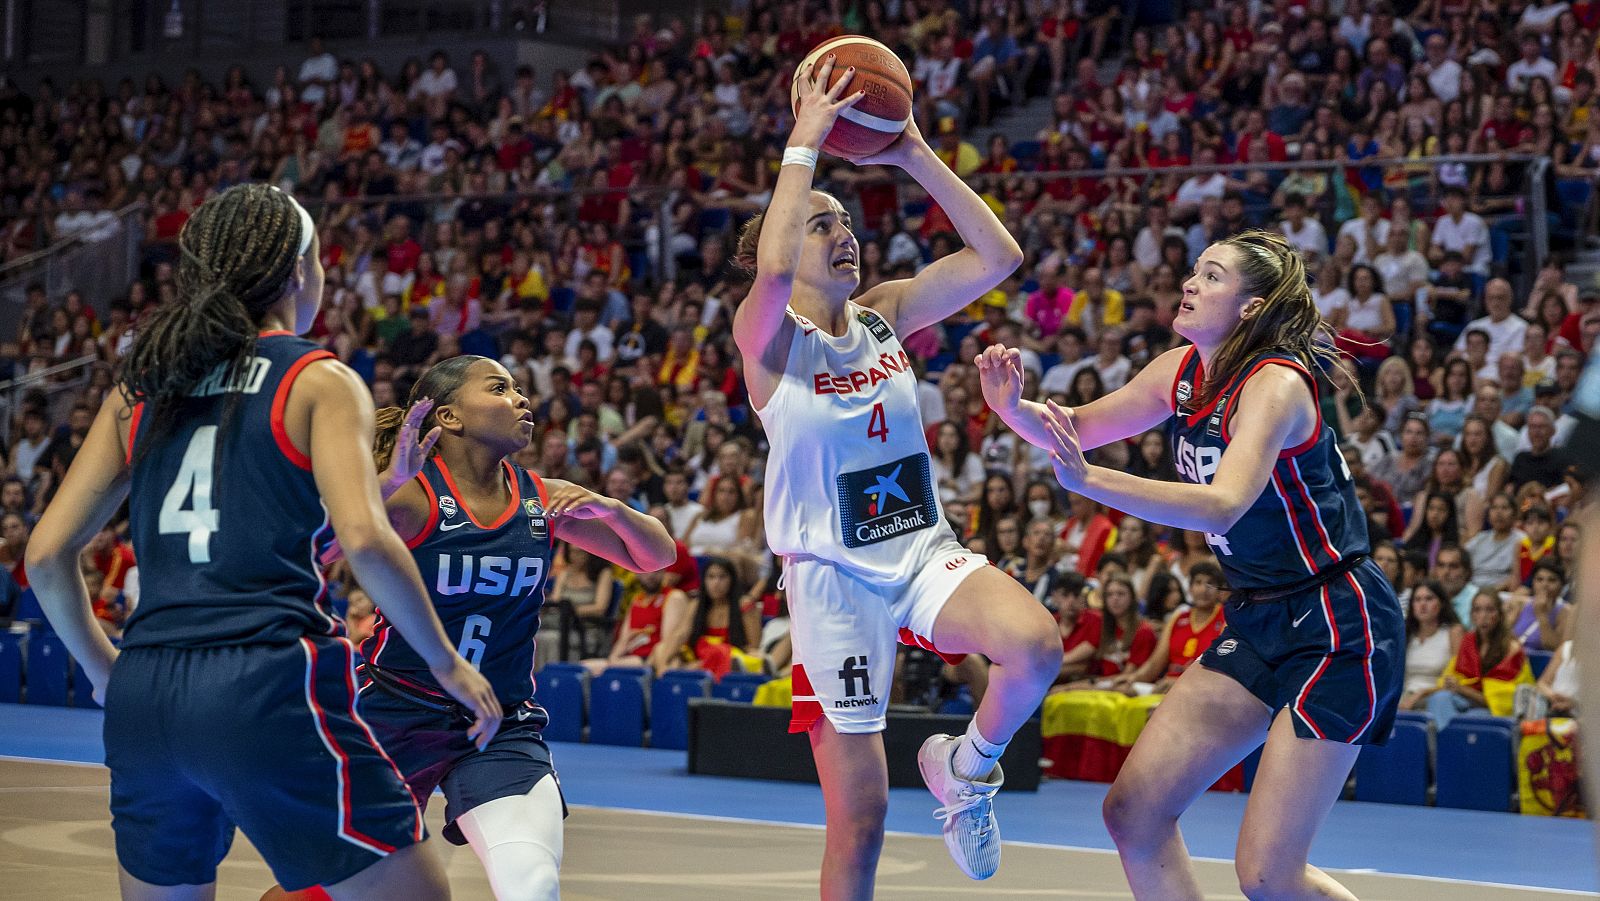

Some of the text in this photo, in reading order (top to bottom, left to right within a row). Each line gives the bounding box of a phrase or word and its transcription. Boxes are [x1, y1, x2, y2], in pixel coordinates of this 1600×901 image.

[813, 350, 911, 395] ESPAÑA
[867, 402, 889, 443] 4
[158, 424, 220, 564] 4
[531, 518, 545, 527] FIBA
[855, 509, 926, 542] CaixaBank
[436, 553, 544, 597] USA
[457, 613, 493, 672] 6
[837, 655, 871, 697] fi
